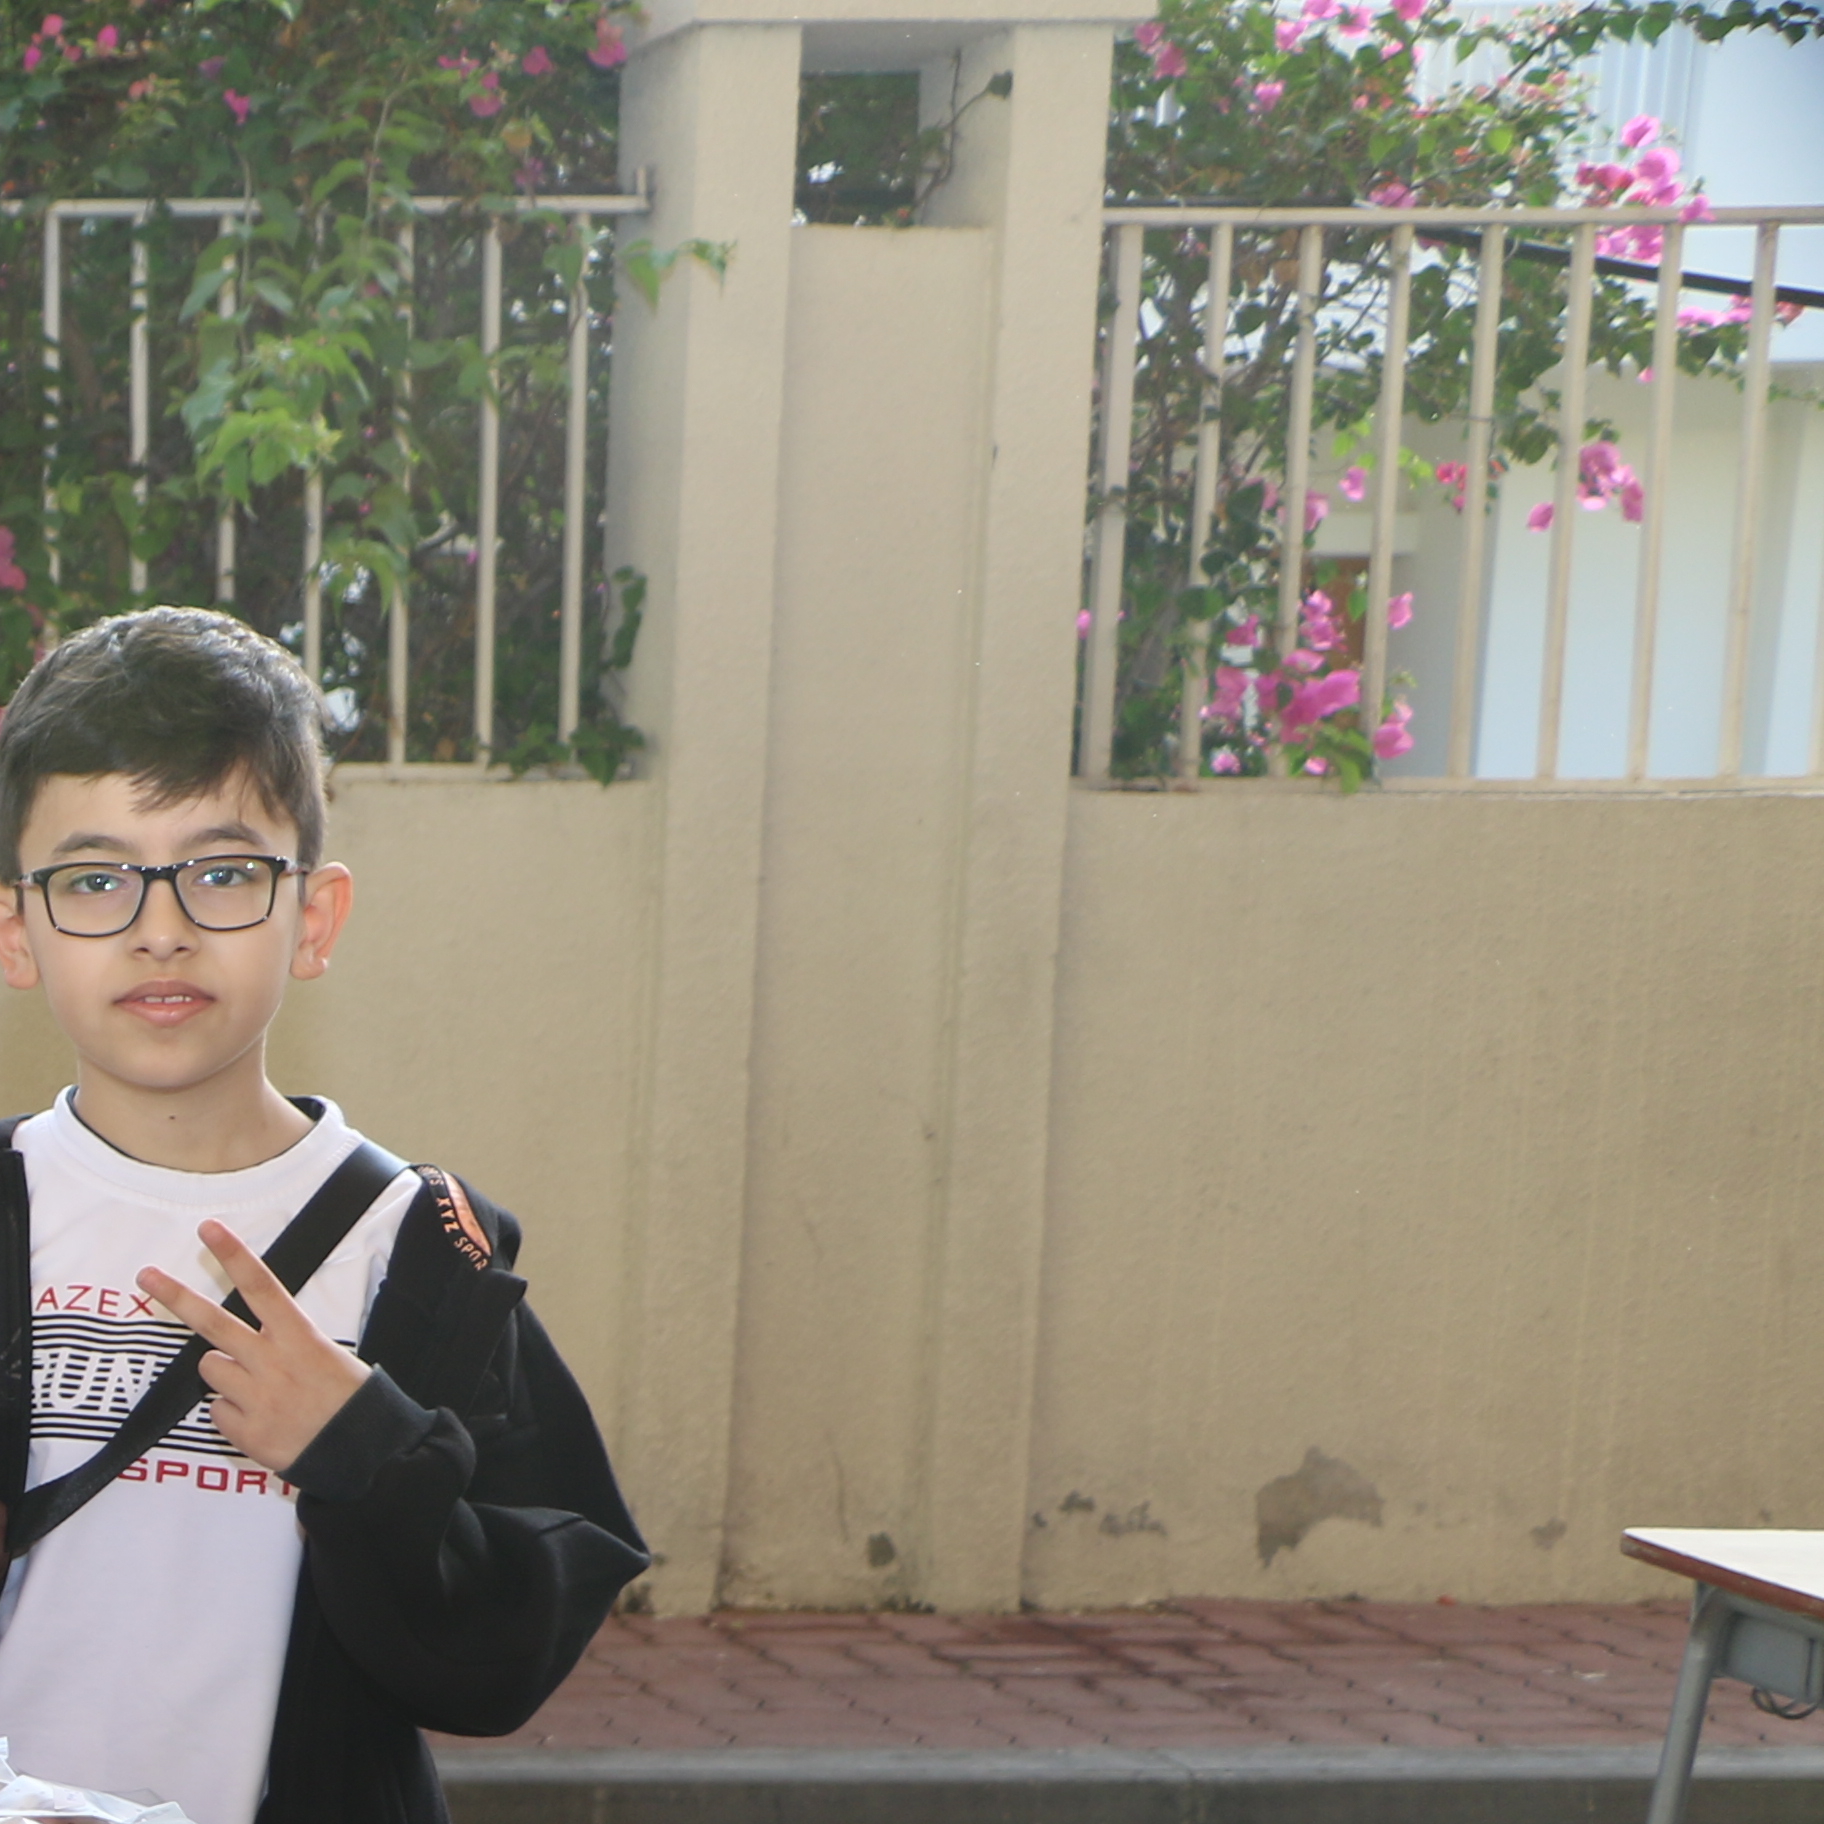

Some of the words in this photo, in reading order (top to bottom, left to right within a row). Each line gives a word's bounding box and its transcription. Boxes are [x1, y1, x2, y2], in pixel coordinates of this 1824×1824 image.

[435, 1197, 460, 1233] XYZ
[452, 1236, 488, 1271] SPOR
[32, 1284, 155, 1318] AZEX
